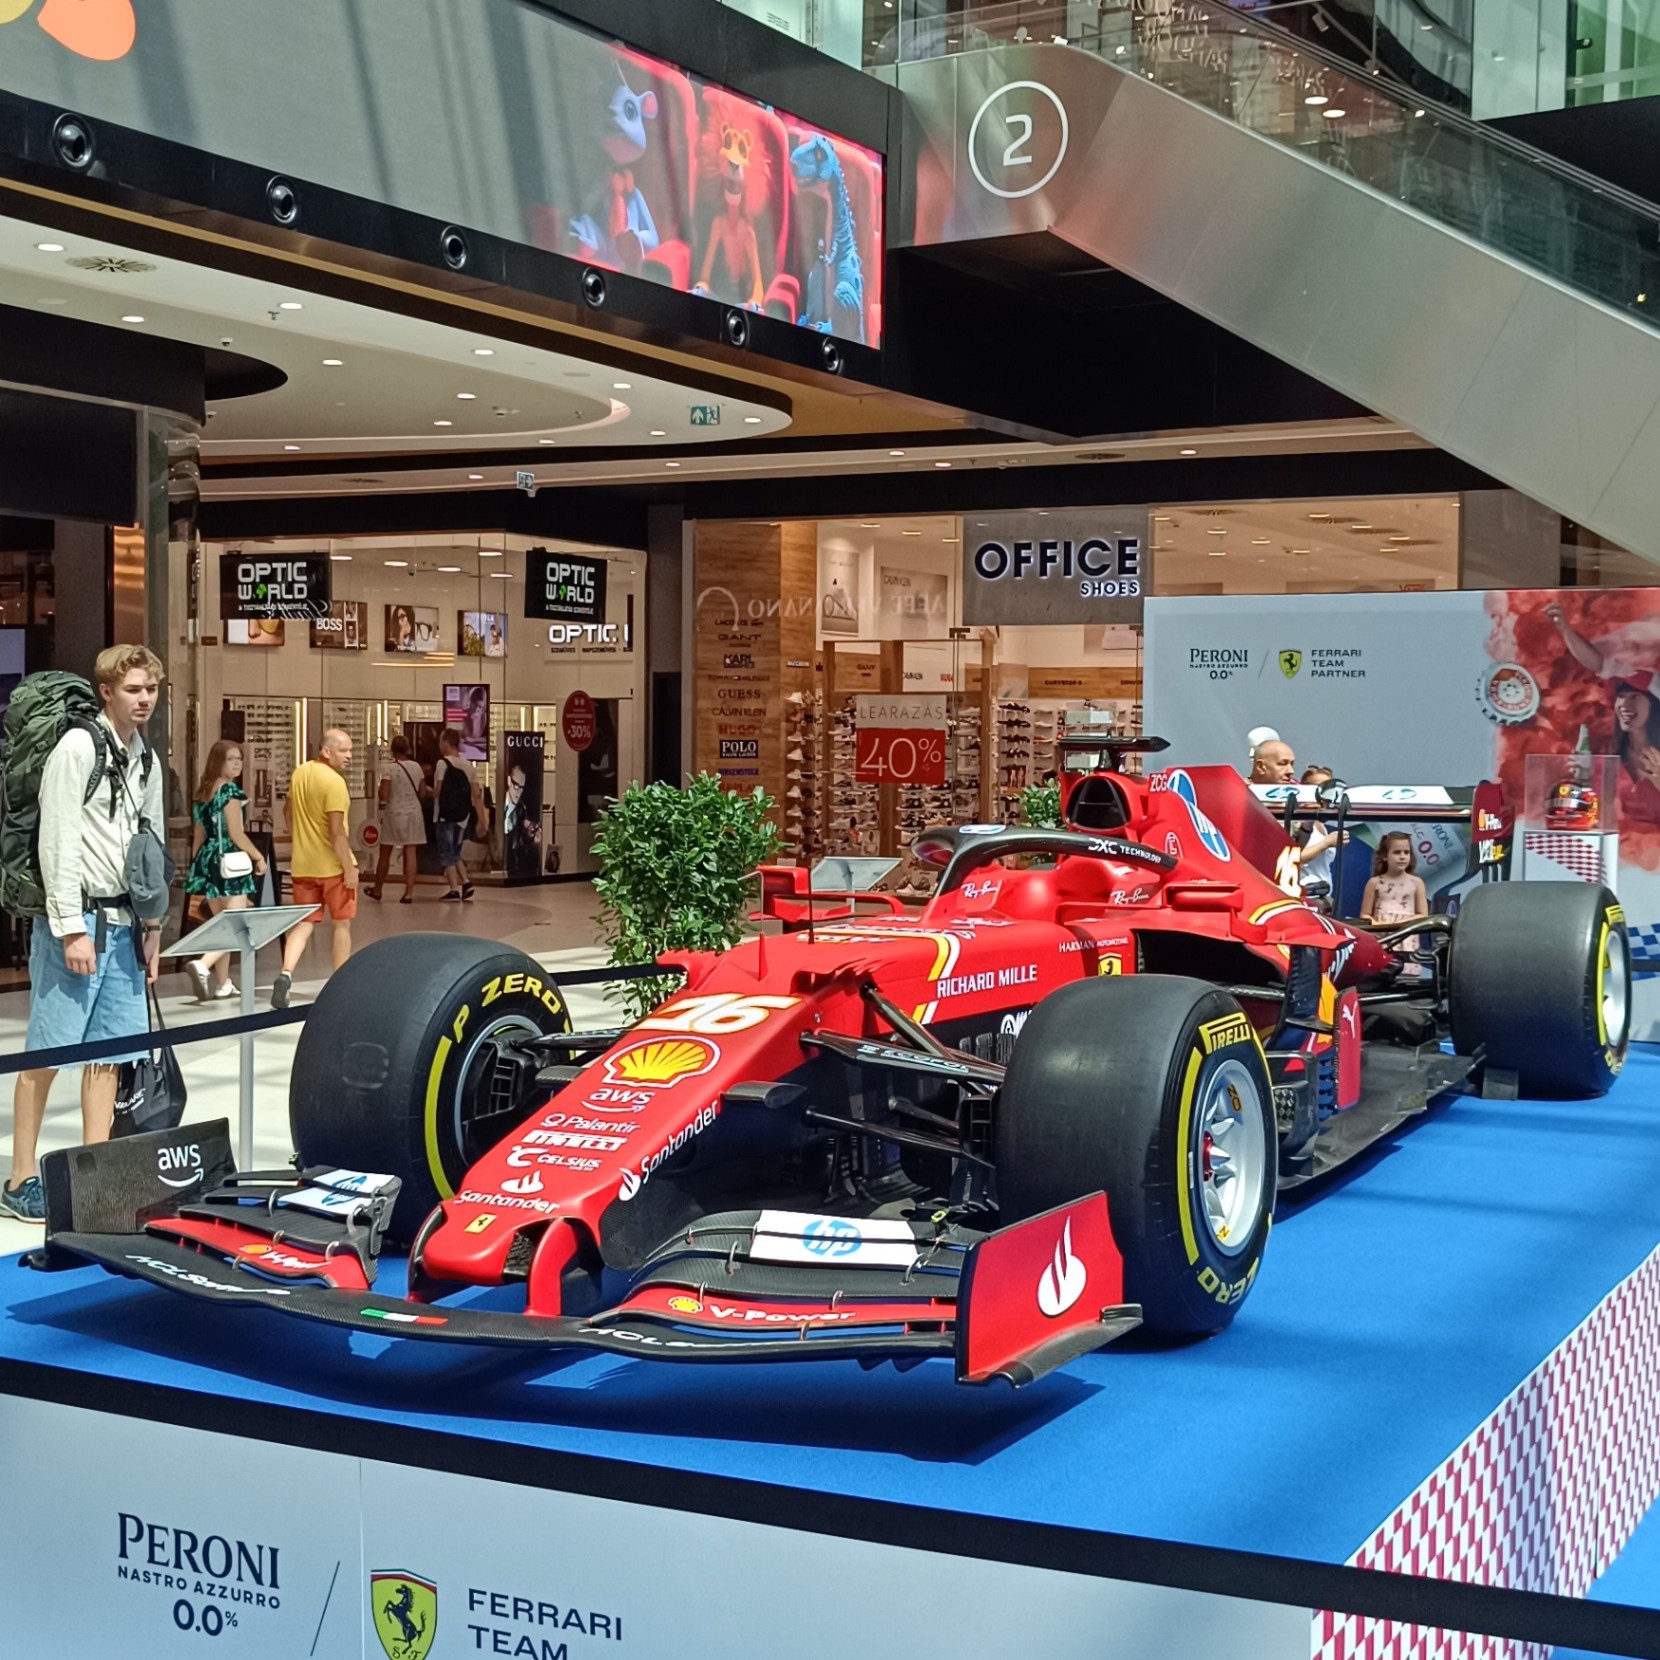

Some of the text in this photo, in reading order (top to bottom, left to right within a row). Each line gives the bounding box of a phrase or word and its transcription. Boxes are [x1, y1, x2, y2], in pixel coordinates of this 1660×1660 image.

[1003, 114, 1033, 166] 2
[975, 539, 1139, 581] OFFICE
[237, 562, 307, 583] OPTIC
[546, 562, 595, 586] OPTIC
[1081, 581, 1139, 597] SHOES
[316, 618, 342, 631] BOSS
[549, 624, 617, 644] OPTIC
[1190, 648, 1248, 663] PERONI
[1311, 649, 1362, 657] FERRARI
[1311, 660, 1344, 668] TEAM
[1311, 670, 1366, 678] PARTNER
[718, 689, 761, 699] GUESS
[712, 707, 766, 717] CALVIN KLEIN
[507, 735, 543, 748] GUCCI
[722, 741, 757, 753] POLO
[861, 737, 942, 779] 40%
[1431, 824, 1454, 849] RONI
[1120, 845, 1162, 864] TECHNOLOGY
[1111, 887, 1149, 904] Ray-Ban
[1059, 940, 1095, 952] HARMAN
[937, 964, 1038, 998] RICHARD MILLE
[453, 973, 562, 1043] P ZERO
[632, 993, 803, 1034] 16
[1199, 1012, 1251, 1054] PIRELLI
[589, 1088, 656, 1105] aws
[562, 1115, 642, 1134] Palantir
[641, 1100, 721, 1184] Santander
[158, 1143, 202, 1169] aws
[536, 1153, 603, 1168] CELSIUS
[454, 1188, 561, 1215] Santander
[803, 1219, 861, 1257] hp
[710, 1304, 857, 1321] V-Power
[118, 1512, 280, 1590] PERONI
[118, 1565, 281, 1610] NASTRO AZZURRO
[173, 1598, 238, 1637] 0.0%
[468, 1588, 622, 1641] FERRARI
[467, 1624, 567, 1660] TEAM
